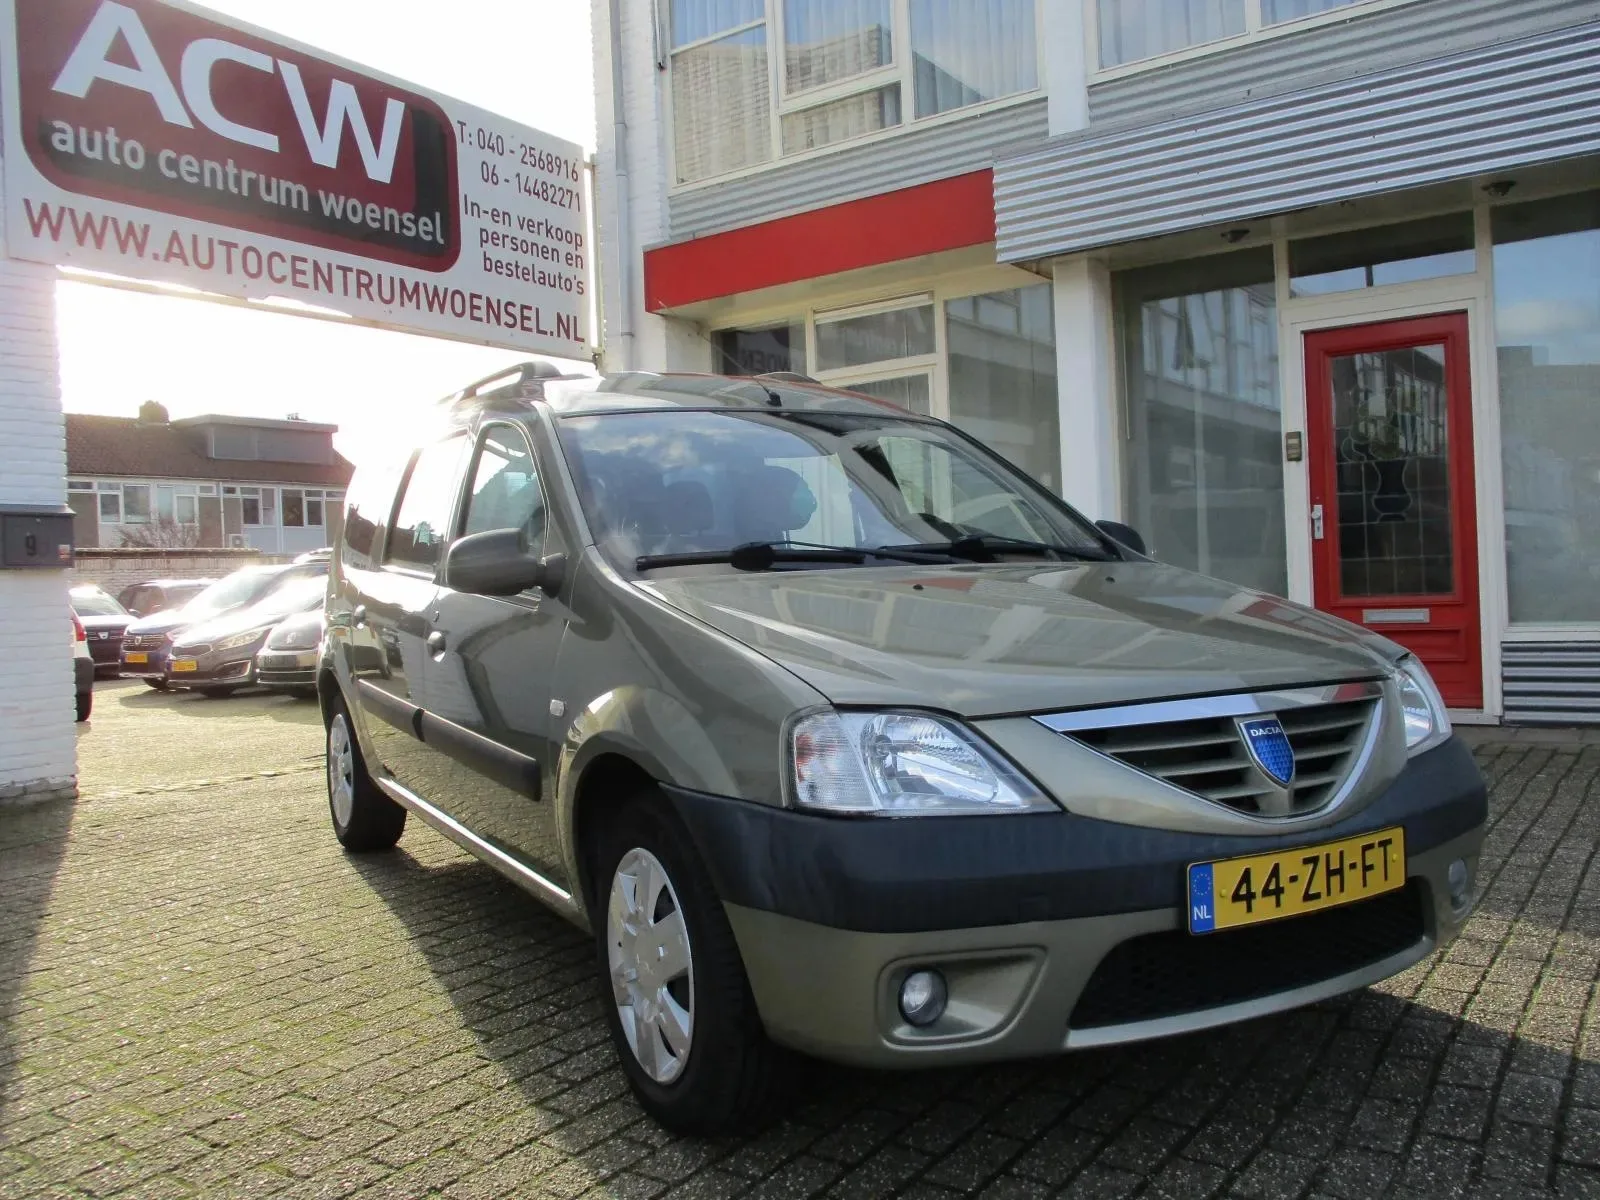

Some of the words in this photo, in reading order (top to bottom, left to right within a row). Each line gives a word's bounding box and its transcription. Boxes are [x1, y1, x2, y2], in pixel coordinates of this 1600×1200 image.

[51, 0, 406, 185] ACW
[457, 120, 473, 146] T:
[477, 128, 505, 156] 040
[520, 143, 579, 183] 2568916
[51, 118, 146, 170] auto
[158, 147, 309, 212] centrum
[318, 188, 445, 245] woensel
[481, 160, 500, 186] 06
[515, 172, 581, 213] 14482271
[464, 194, 512, 227] In-en
[517, 215, 583, 250] verkoop
[479, 227, 560, 263] personen
[565, 251, 584, 270] en
[23, 197, 585, 344] WWW.AUTOCENTRUMWOENSEL.NL
[483, 251, 585, 295] bestelauto's
[1250, 726, 1282, 737] DACIA
[1231, 838, 1393, 913] 44-ZH-FT
[1193, 904, 1212, 921] NL
